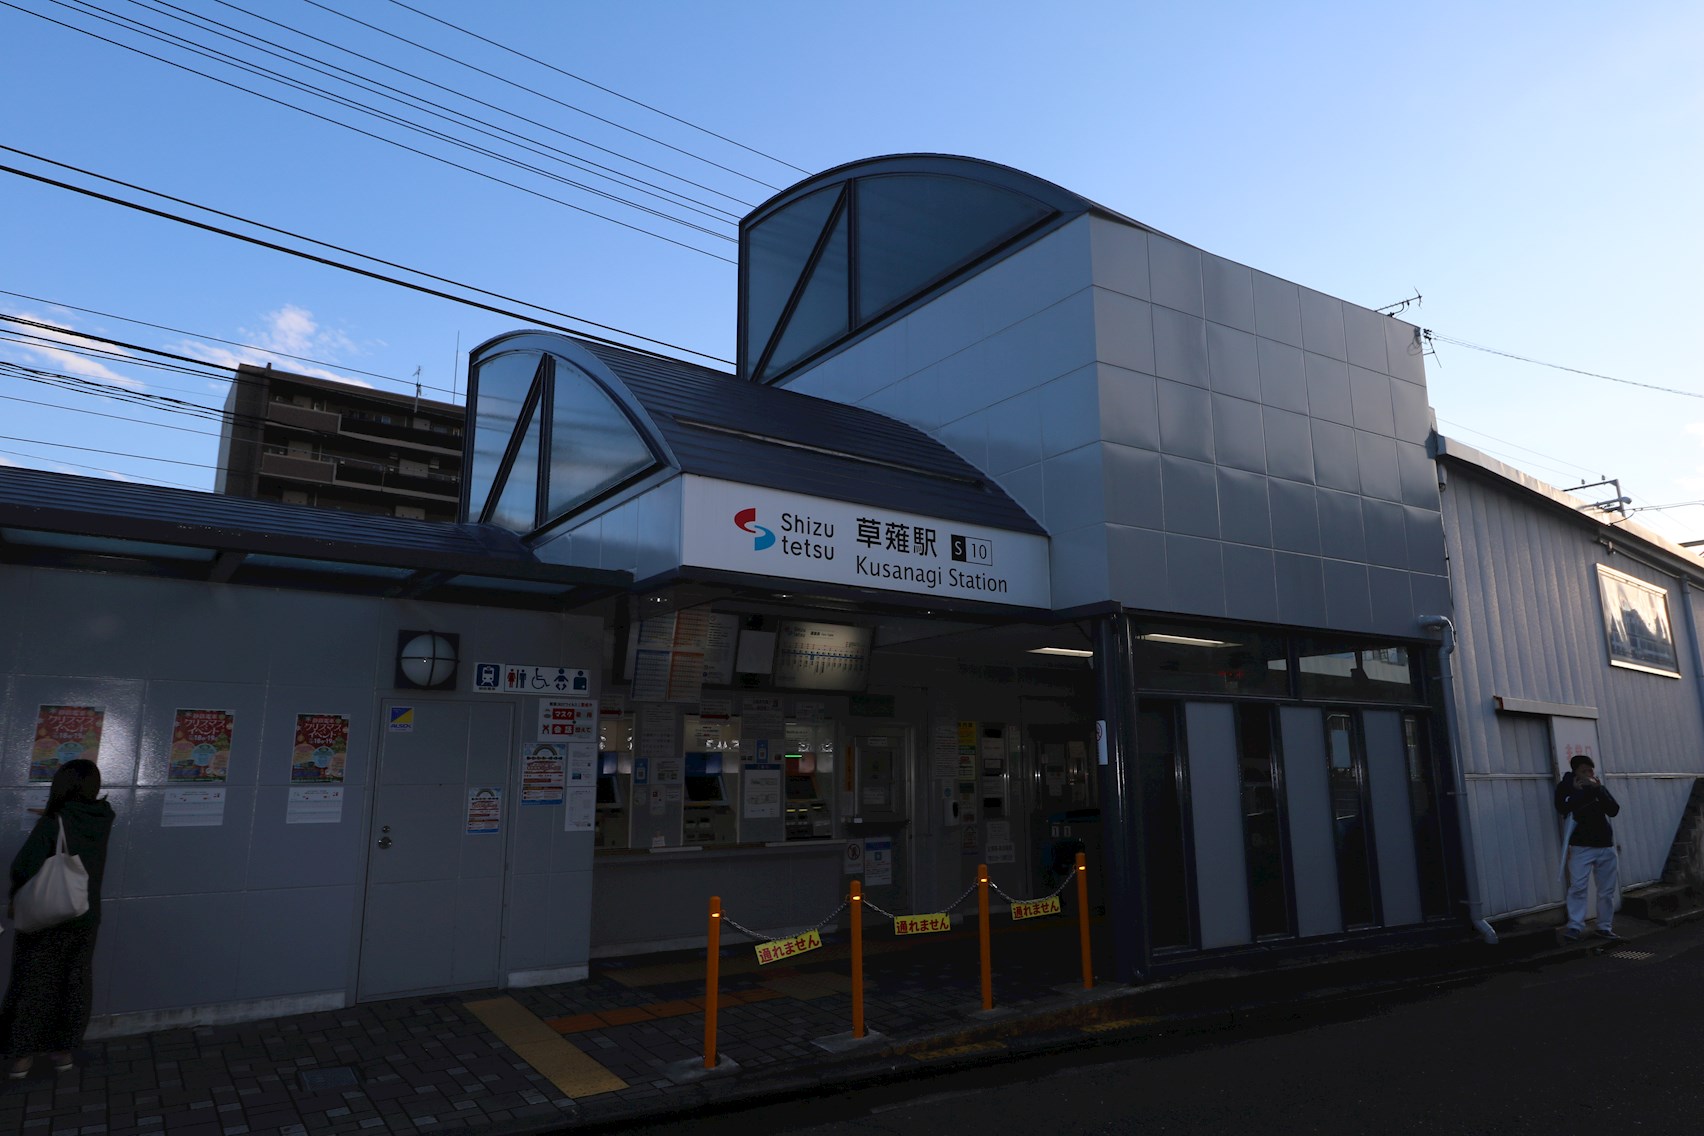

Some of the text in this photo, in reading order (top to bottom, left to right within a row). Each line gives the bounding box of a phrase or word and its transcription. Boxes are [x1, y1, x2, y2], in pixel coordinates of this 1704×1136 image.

[781, 513, 834, 538] Shizu
[856, 517, 937, 557] 草薙駅
[782, 536, 834, 560] tetsu
[954, 541, 987, 560] S 10
[856, 555, 1008, 593] Kusanagi Station
[184, 719, 225, 728] クリスマス
[187, 727, 220, 735] イベント
[304, 723, 342, 732] クリスマス
[1013, 901, 1059, 918] 通れません
[896, 918, 949, 934] 通れません
[759, 935, 819, 963] 通れません
